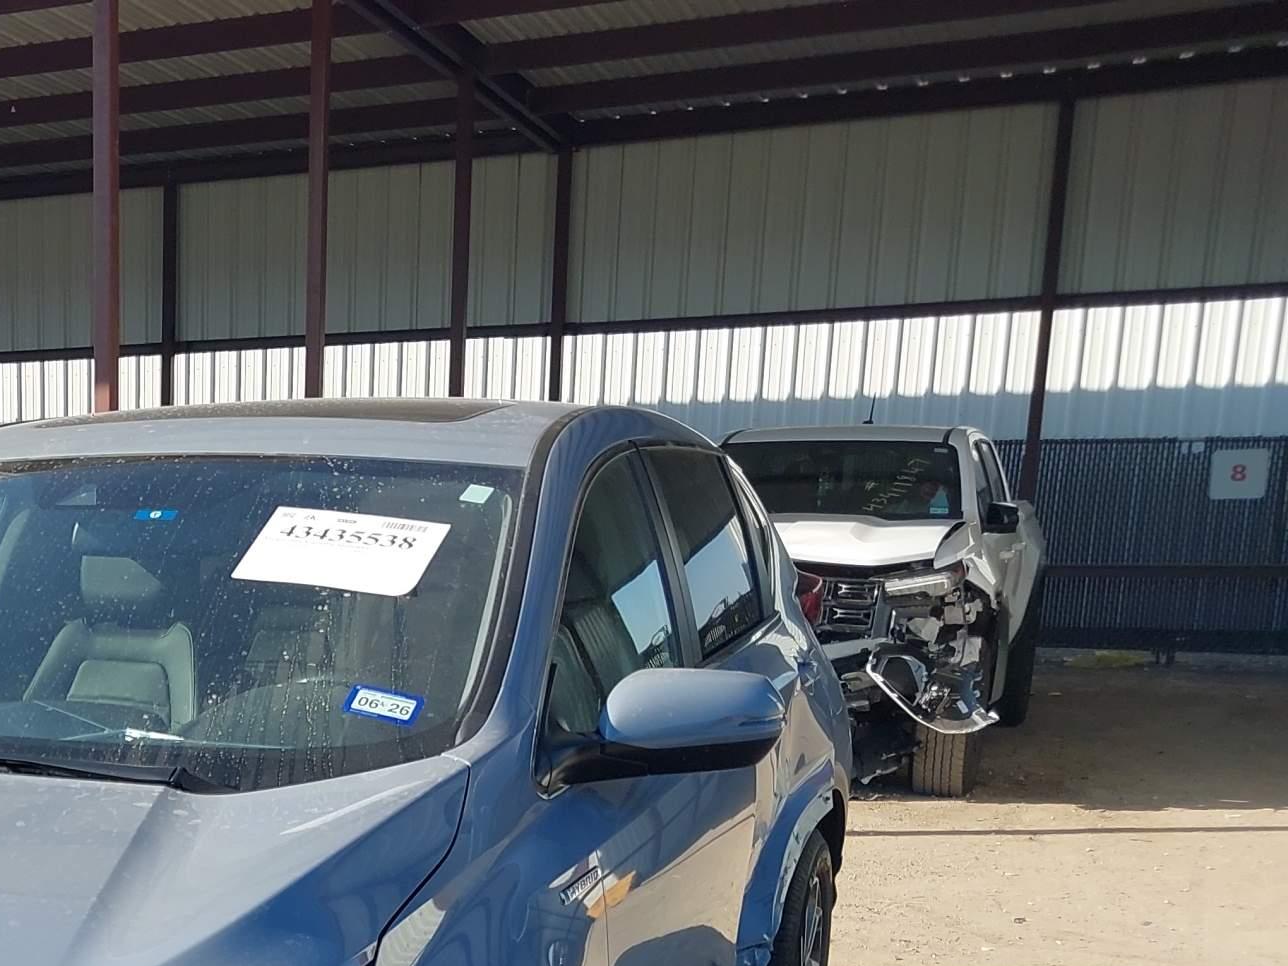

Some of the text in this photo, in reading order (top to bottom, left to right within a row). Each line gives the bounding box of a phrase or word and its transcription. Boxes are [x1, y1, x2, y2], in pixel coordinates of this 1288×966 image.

[1230, 463, 1247, 482] 8
[279, 524, 417, 550] 43435538
[358, 696, 411, 716] 06 26
[567, 870, 600, 898] HYBRID
